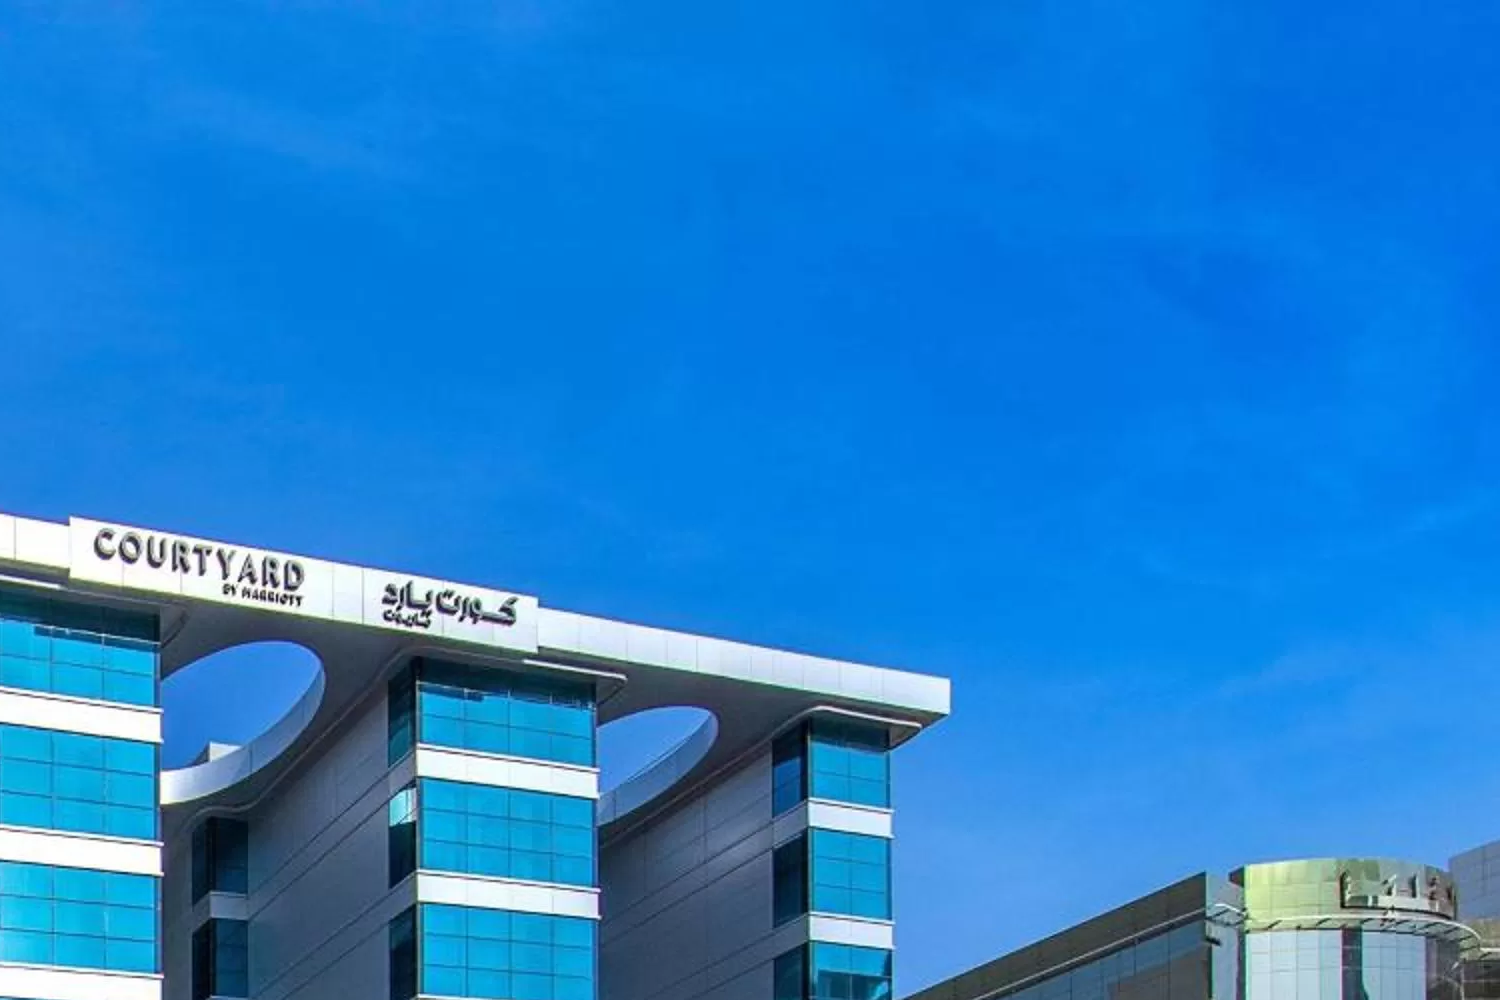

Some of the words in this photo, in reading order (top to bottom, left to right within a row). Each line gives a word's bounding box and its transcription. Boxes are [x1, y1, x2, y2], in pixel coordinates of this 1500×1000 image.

[94, 527, 305, 592] COURTYARD
[222, 583, 238, 597] BY
[241, 586, 304, 607] MARRIOTT
